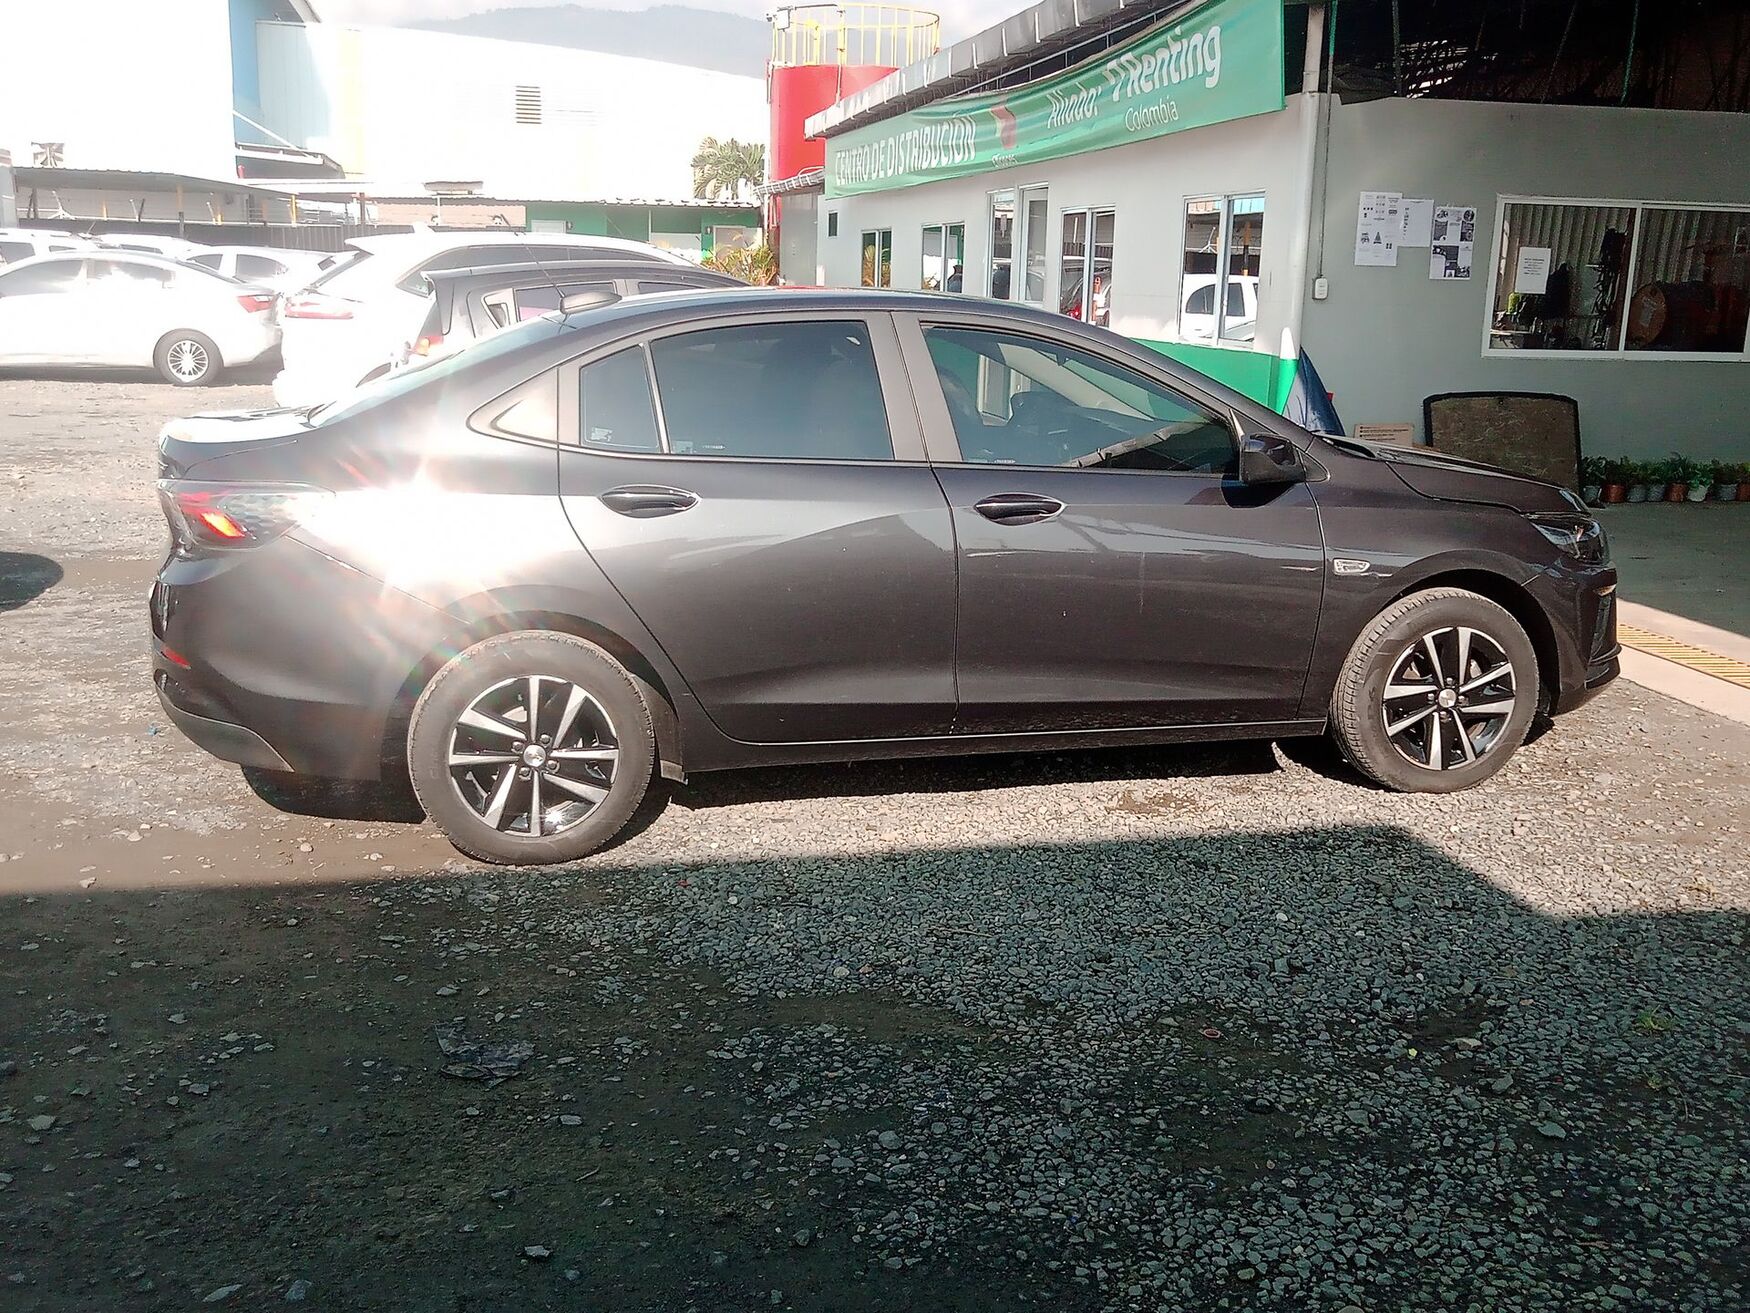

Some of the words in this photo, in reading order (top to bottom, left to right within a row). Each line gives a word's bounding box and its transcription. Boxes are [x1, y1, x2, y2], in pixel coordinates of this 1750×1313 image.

[1125, 96, 1179, 132] Colombia
[834, 144, 870, 187] CENTRO
[871, 139, 885, 180] DE
